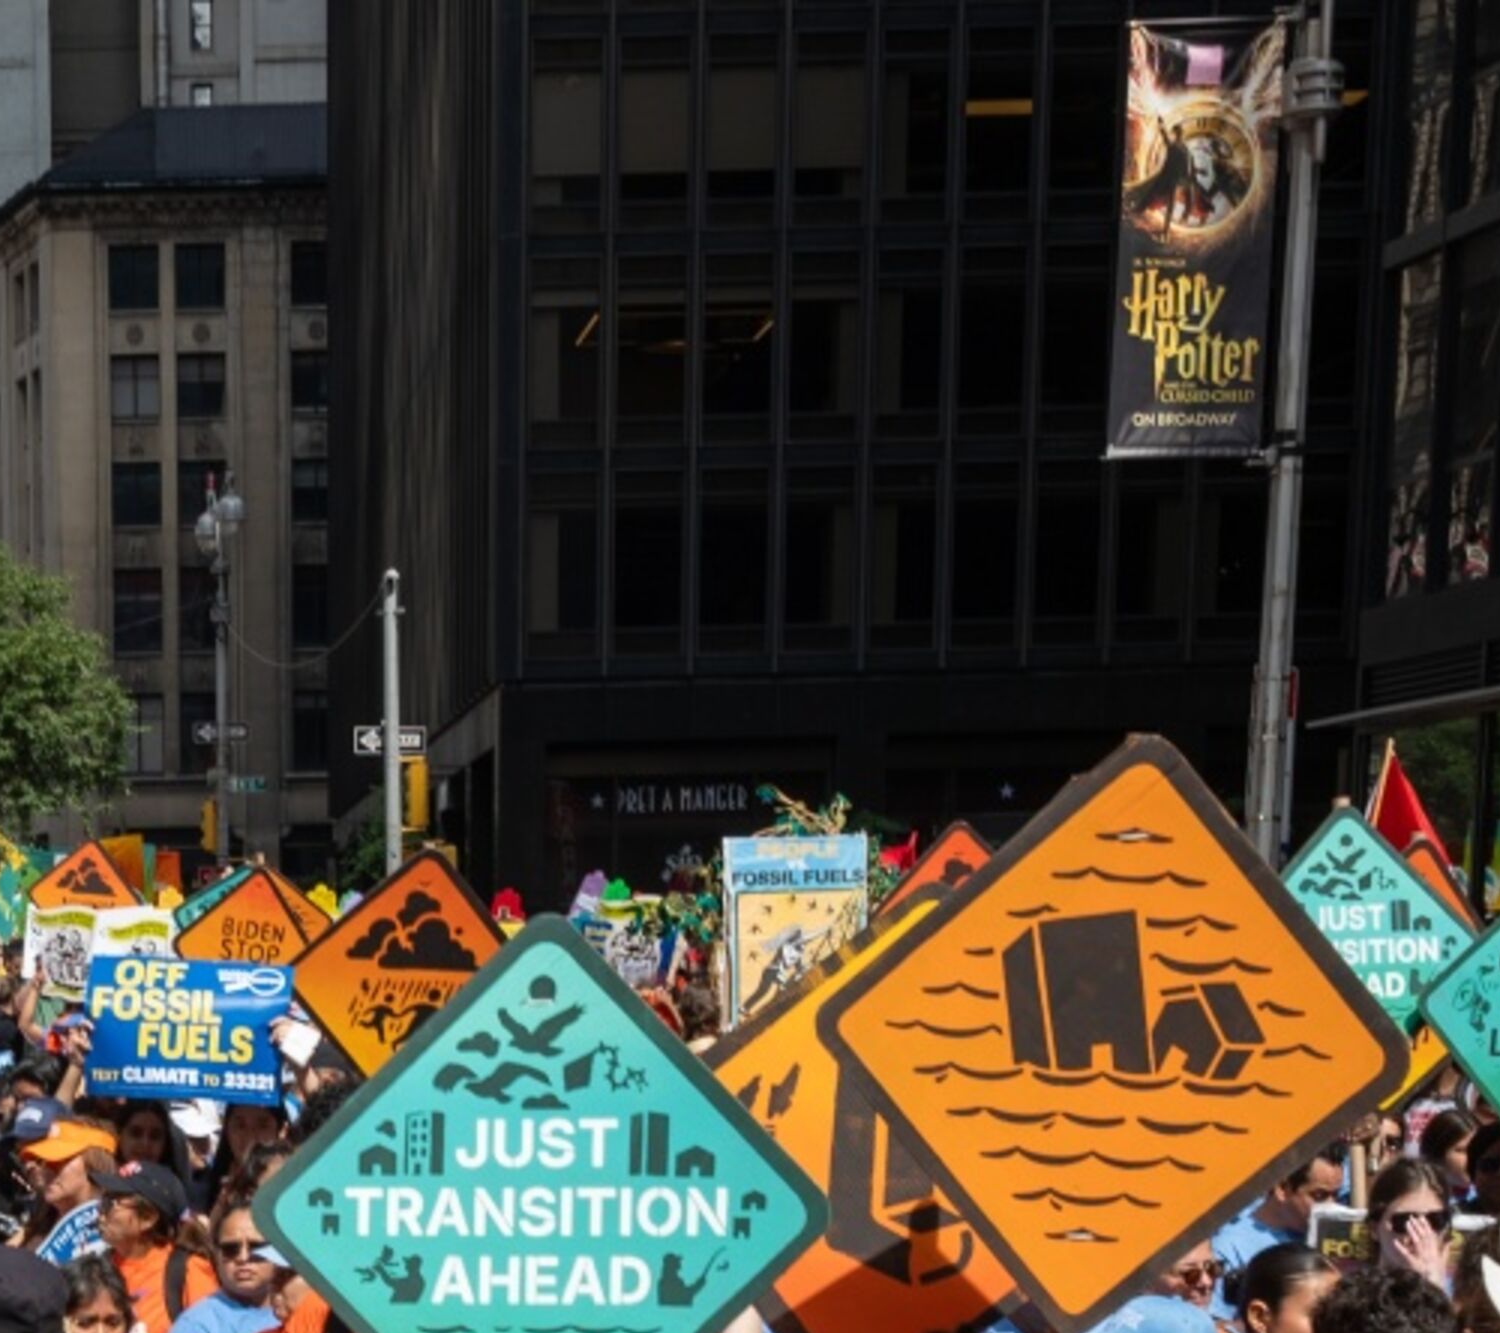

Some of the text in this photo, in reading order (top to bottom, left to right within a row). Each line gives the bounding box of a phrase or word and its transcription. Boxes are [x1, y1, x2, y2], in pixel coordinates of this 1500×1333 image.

[1122, 268, 1225, 341] Harry
[1155, 320, 1260, 400] Potter
[1133, 412, 1237, 427] ON BROADWAY
[618, 785, 747, 814] PRET A MANGER
[732, 869, 864, 886] FOSSIL FUELS
[222, 917, 286, 943] BIDEN
[220, 939, 281, 964] STOP
[1333, 938, 1440, 965] SITION
[114, 959, 189, 988] OFF
[91, 986, 223, 1024] FOSSIL
[137, 1022, 255, 1064] FUELS
[123, 1066, 199, 1087] CLIMATE
[203, 1074, 220, 1087] TO
[455, 1117, 619, 1169] JUST
[344, 1187, 728, 1238] TRANSITION
[431, 1255, 652, 1306] AHEAD
